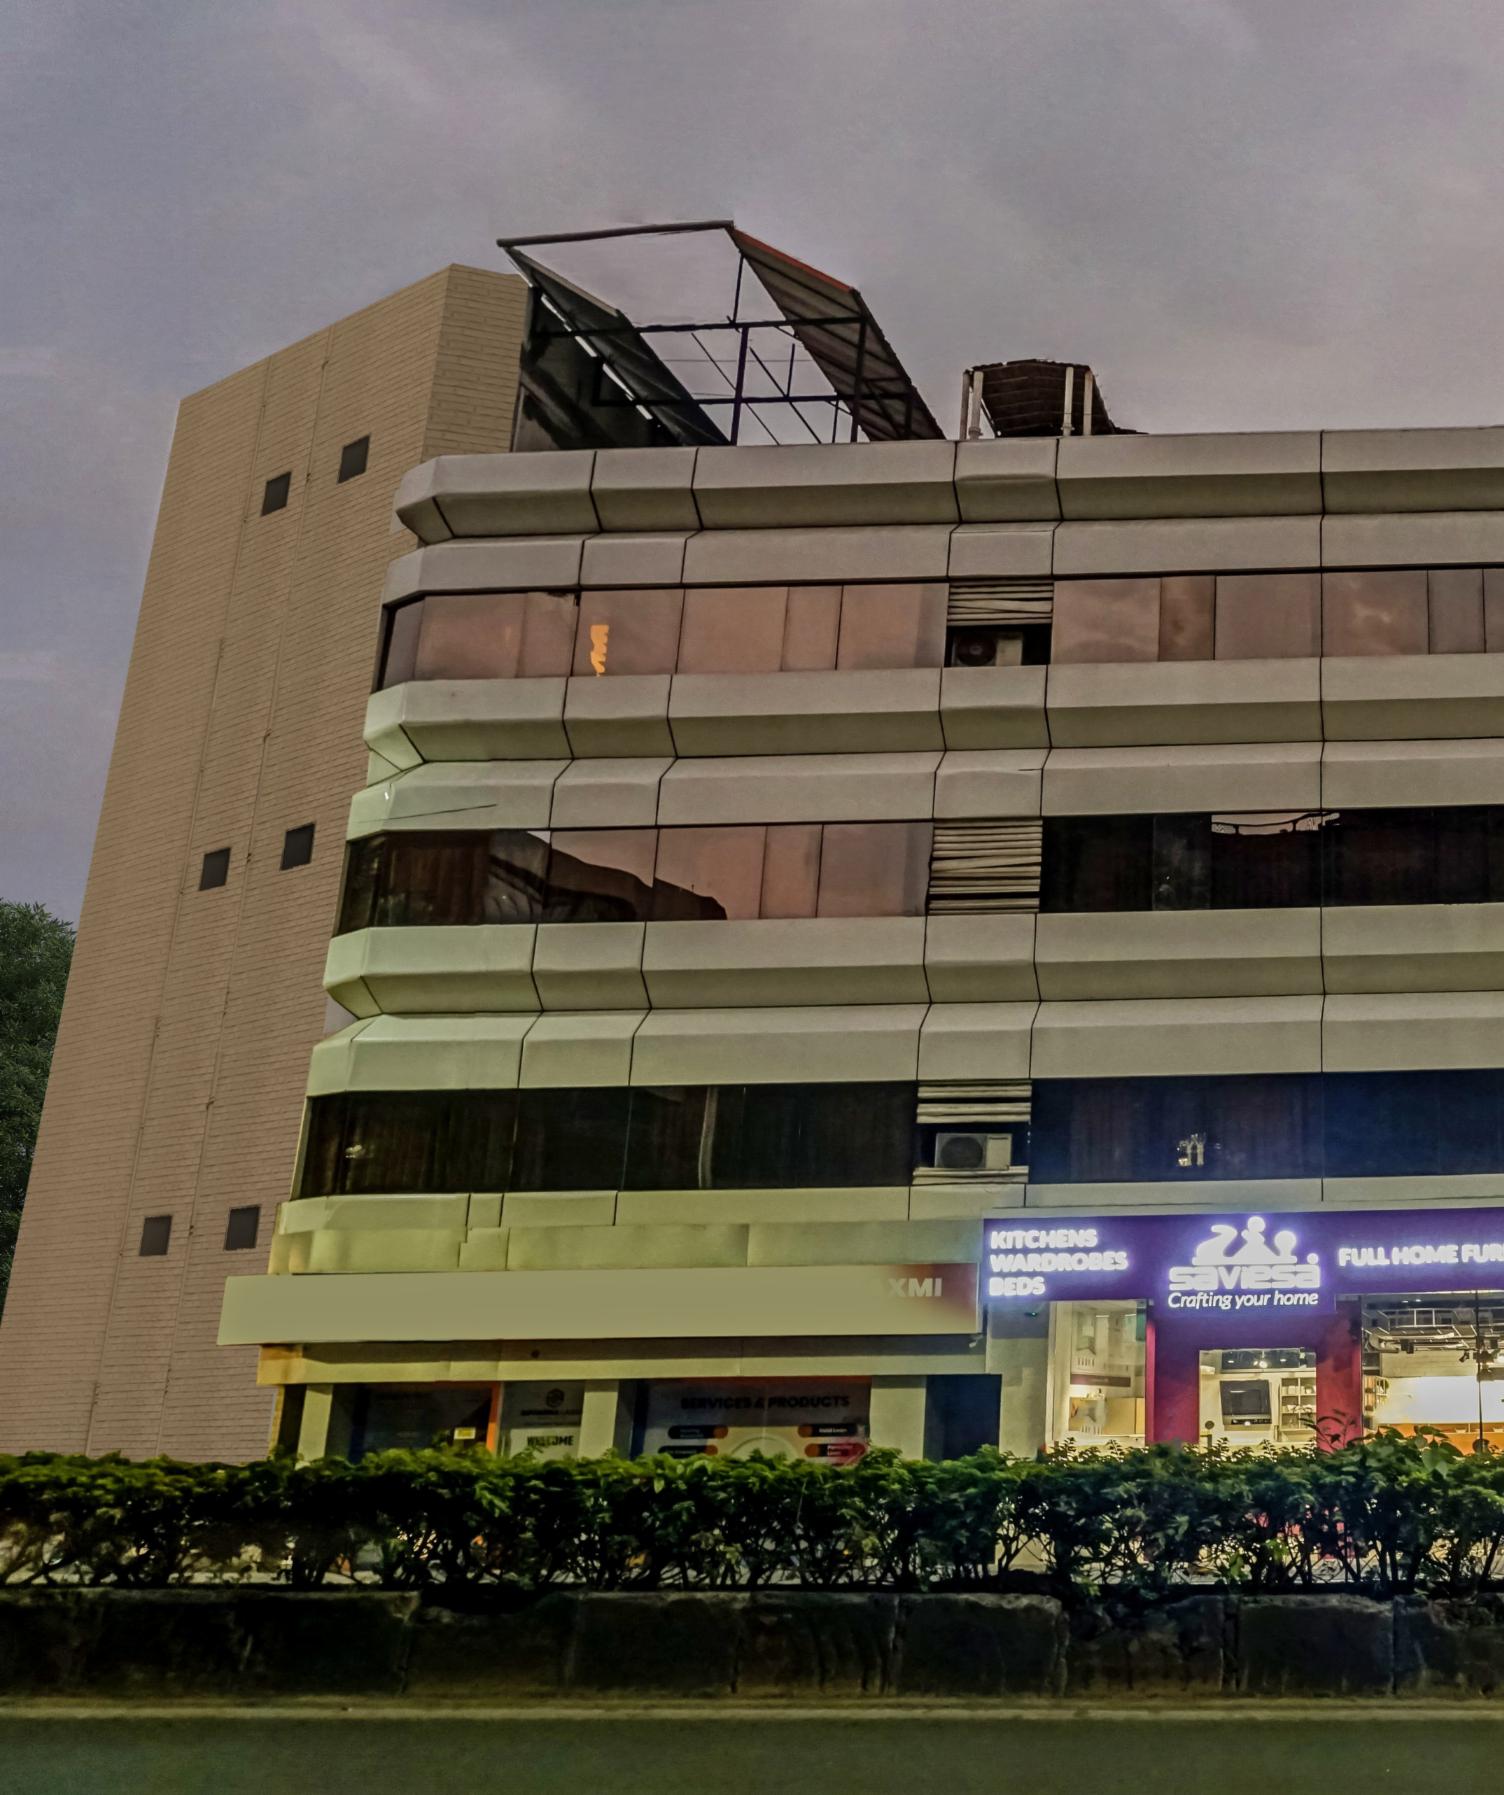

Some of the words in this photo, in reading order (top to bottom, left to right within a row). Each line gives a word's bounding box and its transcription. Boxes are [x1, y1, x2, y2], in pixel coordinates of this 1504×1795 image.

[990, 1229, 1098, 1249] KITCHENS
[989, 1251, 1129, 1273] WARDROBES
[1339, 1246, 1390, 1267] FULL
[1391, 1244, 1459, 1265] HOME
[988, 1276, 1046, 1297] BEDS
[1168, 1263, 1321, 1291] saviesa
[1168, 1291, 1232, 1310] Crafting
[1234, 1294, 1271, 1310] your
[1273, 1290, 1319, 1306] home
[681, 1396, 752, 1410] SERVICES
[768, 1395, 850, 1409] PRODUCTS
